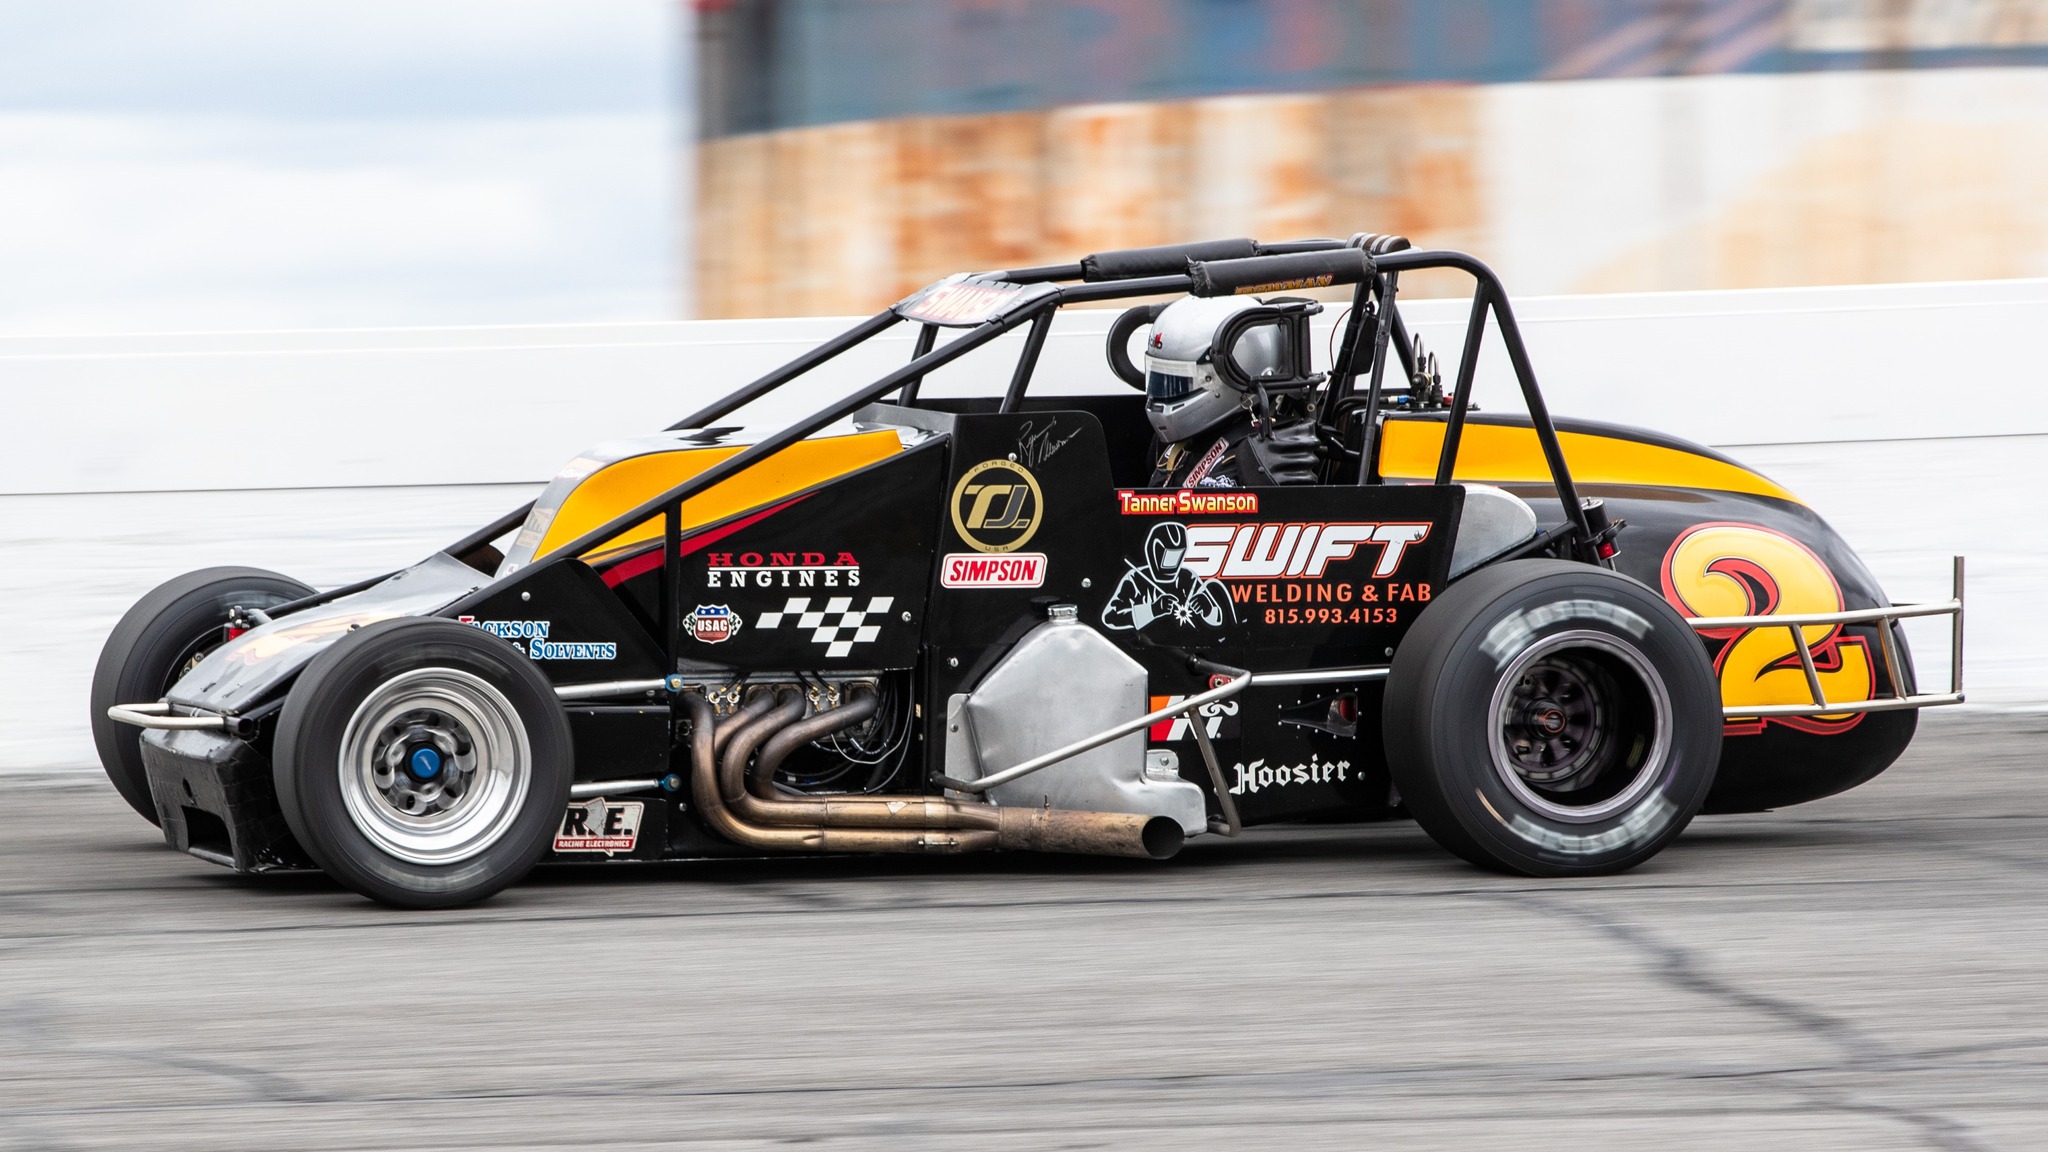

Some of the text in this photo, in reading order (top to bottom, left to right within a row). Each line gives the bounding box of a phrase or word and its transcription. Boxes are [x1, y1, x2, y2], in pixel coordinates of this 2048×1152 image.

[973, 460, 1024, 474] FORGED
[1188, 443, 1223, 487] SIMPSON
[1119, 491, 1257, 513] Tanner Swanson
[707, 552, 860, 567] HONDA
[1183, 522, 1433, 579] SWIFT
[707, 570, 860, 588] ENGINES
[950, 560, 1037, 582] SIMPSON
[1231, 583, 1432, 603] WELDING & FAB
[697, 619, 729, 633] USAC
[1264, 608, 1398, 625] 815.993.4153
[1660, 521, 1876, 736] 2
[1229, 753, 1351, 796] Hoosier
[558, 840, 630, 848] RACING ELECTRONICS
